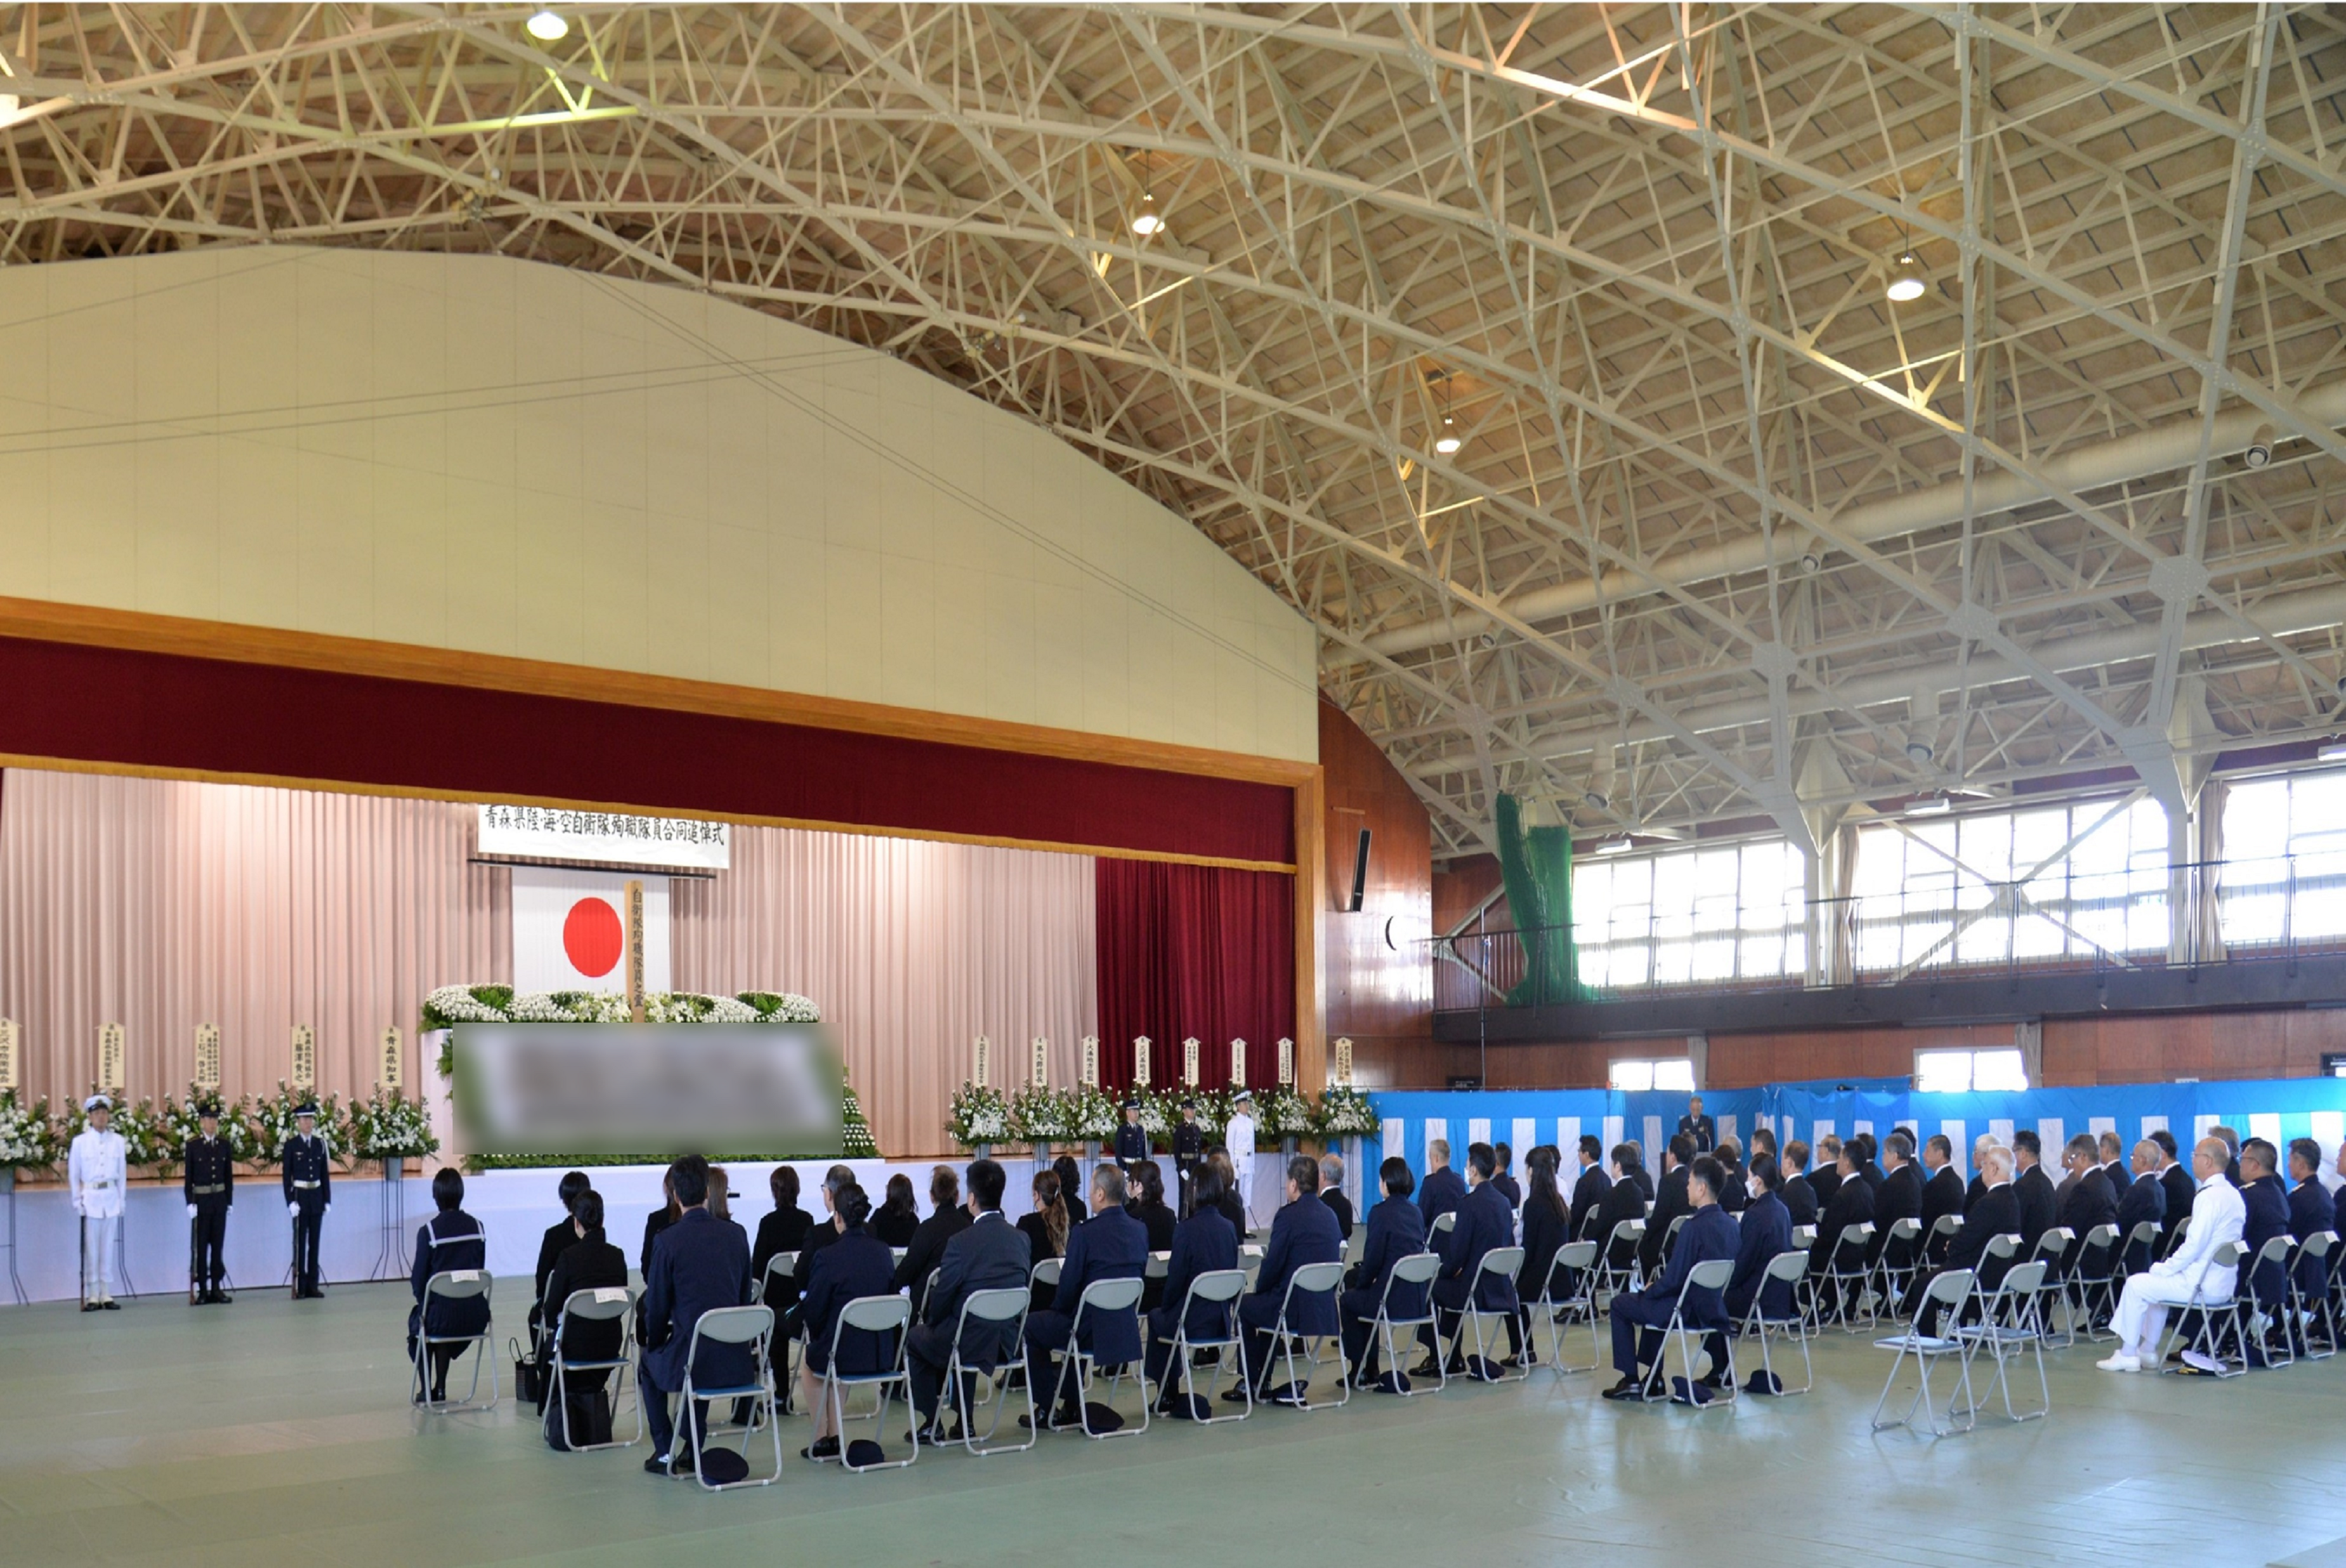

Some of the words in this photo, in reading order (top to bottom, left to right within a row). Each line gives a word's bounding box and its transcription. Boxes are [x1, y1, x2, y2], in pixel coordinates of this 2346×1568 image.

[386, 1036, 396, 1083] 青森県知事
